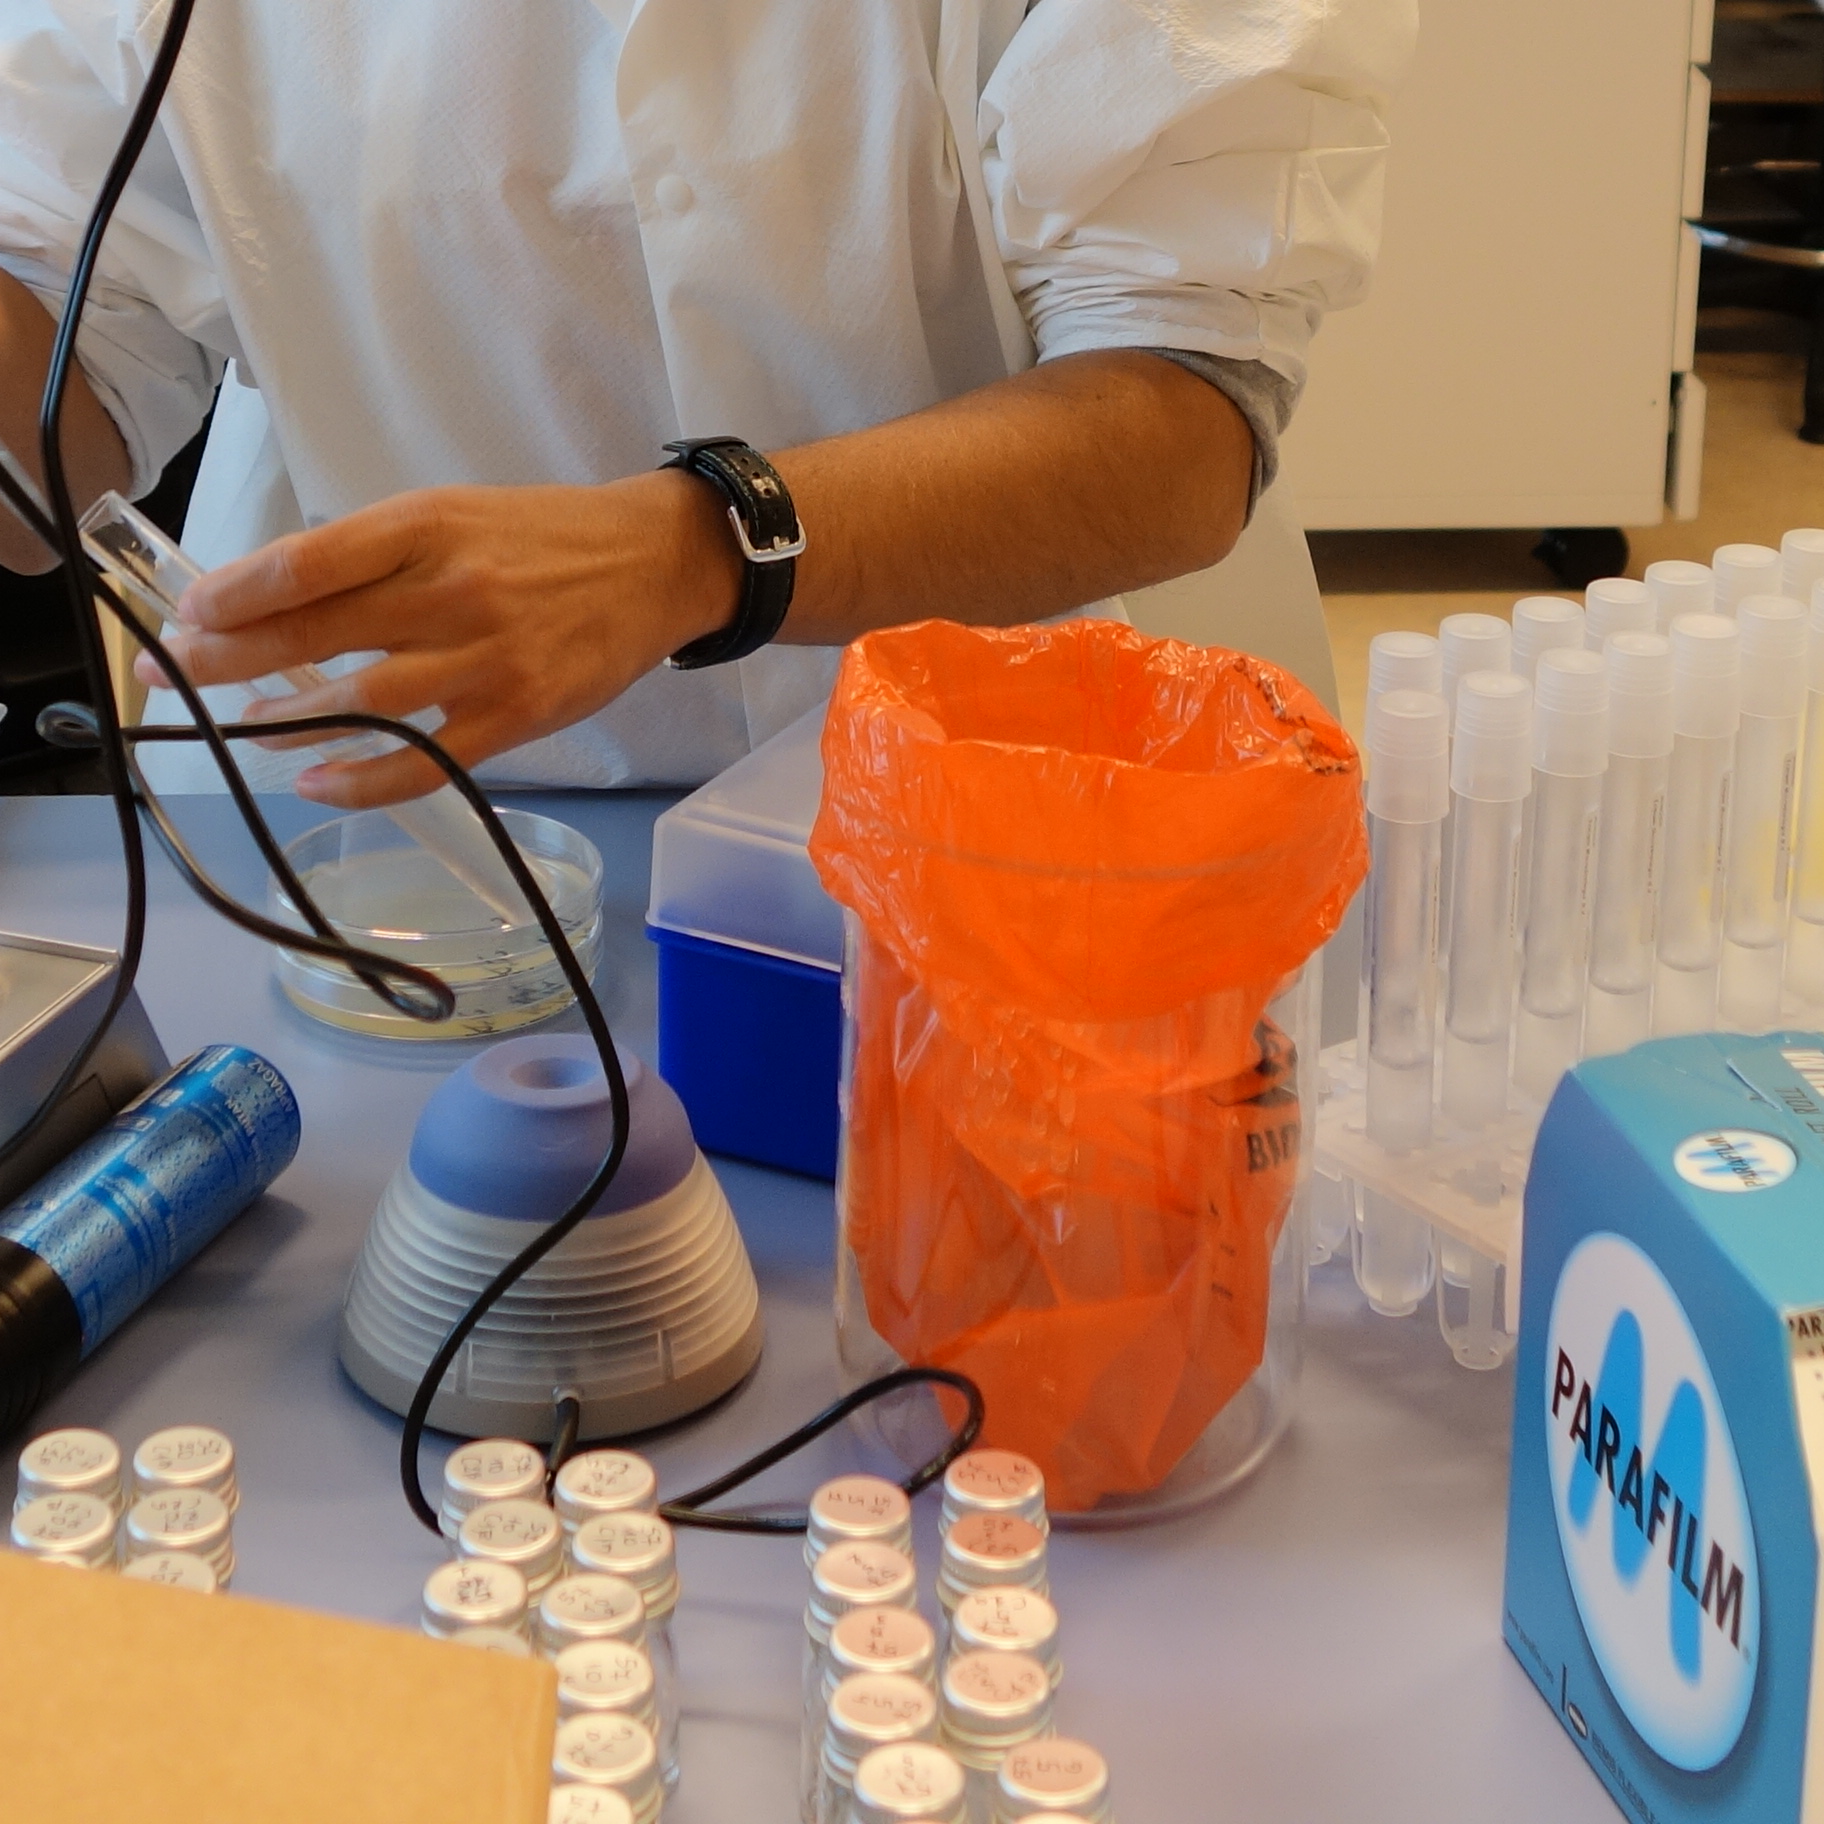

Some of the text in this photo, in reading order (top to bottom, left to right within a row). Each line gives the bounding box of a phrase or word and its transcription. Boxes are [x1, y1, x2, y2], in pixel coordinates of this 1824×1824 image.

[1774, 1086, 1821, 1116] ROLL
[1704, 1135, 1767, 1189] PARAFILM
[1551, 1345, 1745, 1650] PARAFILM
